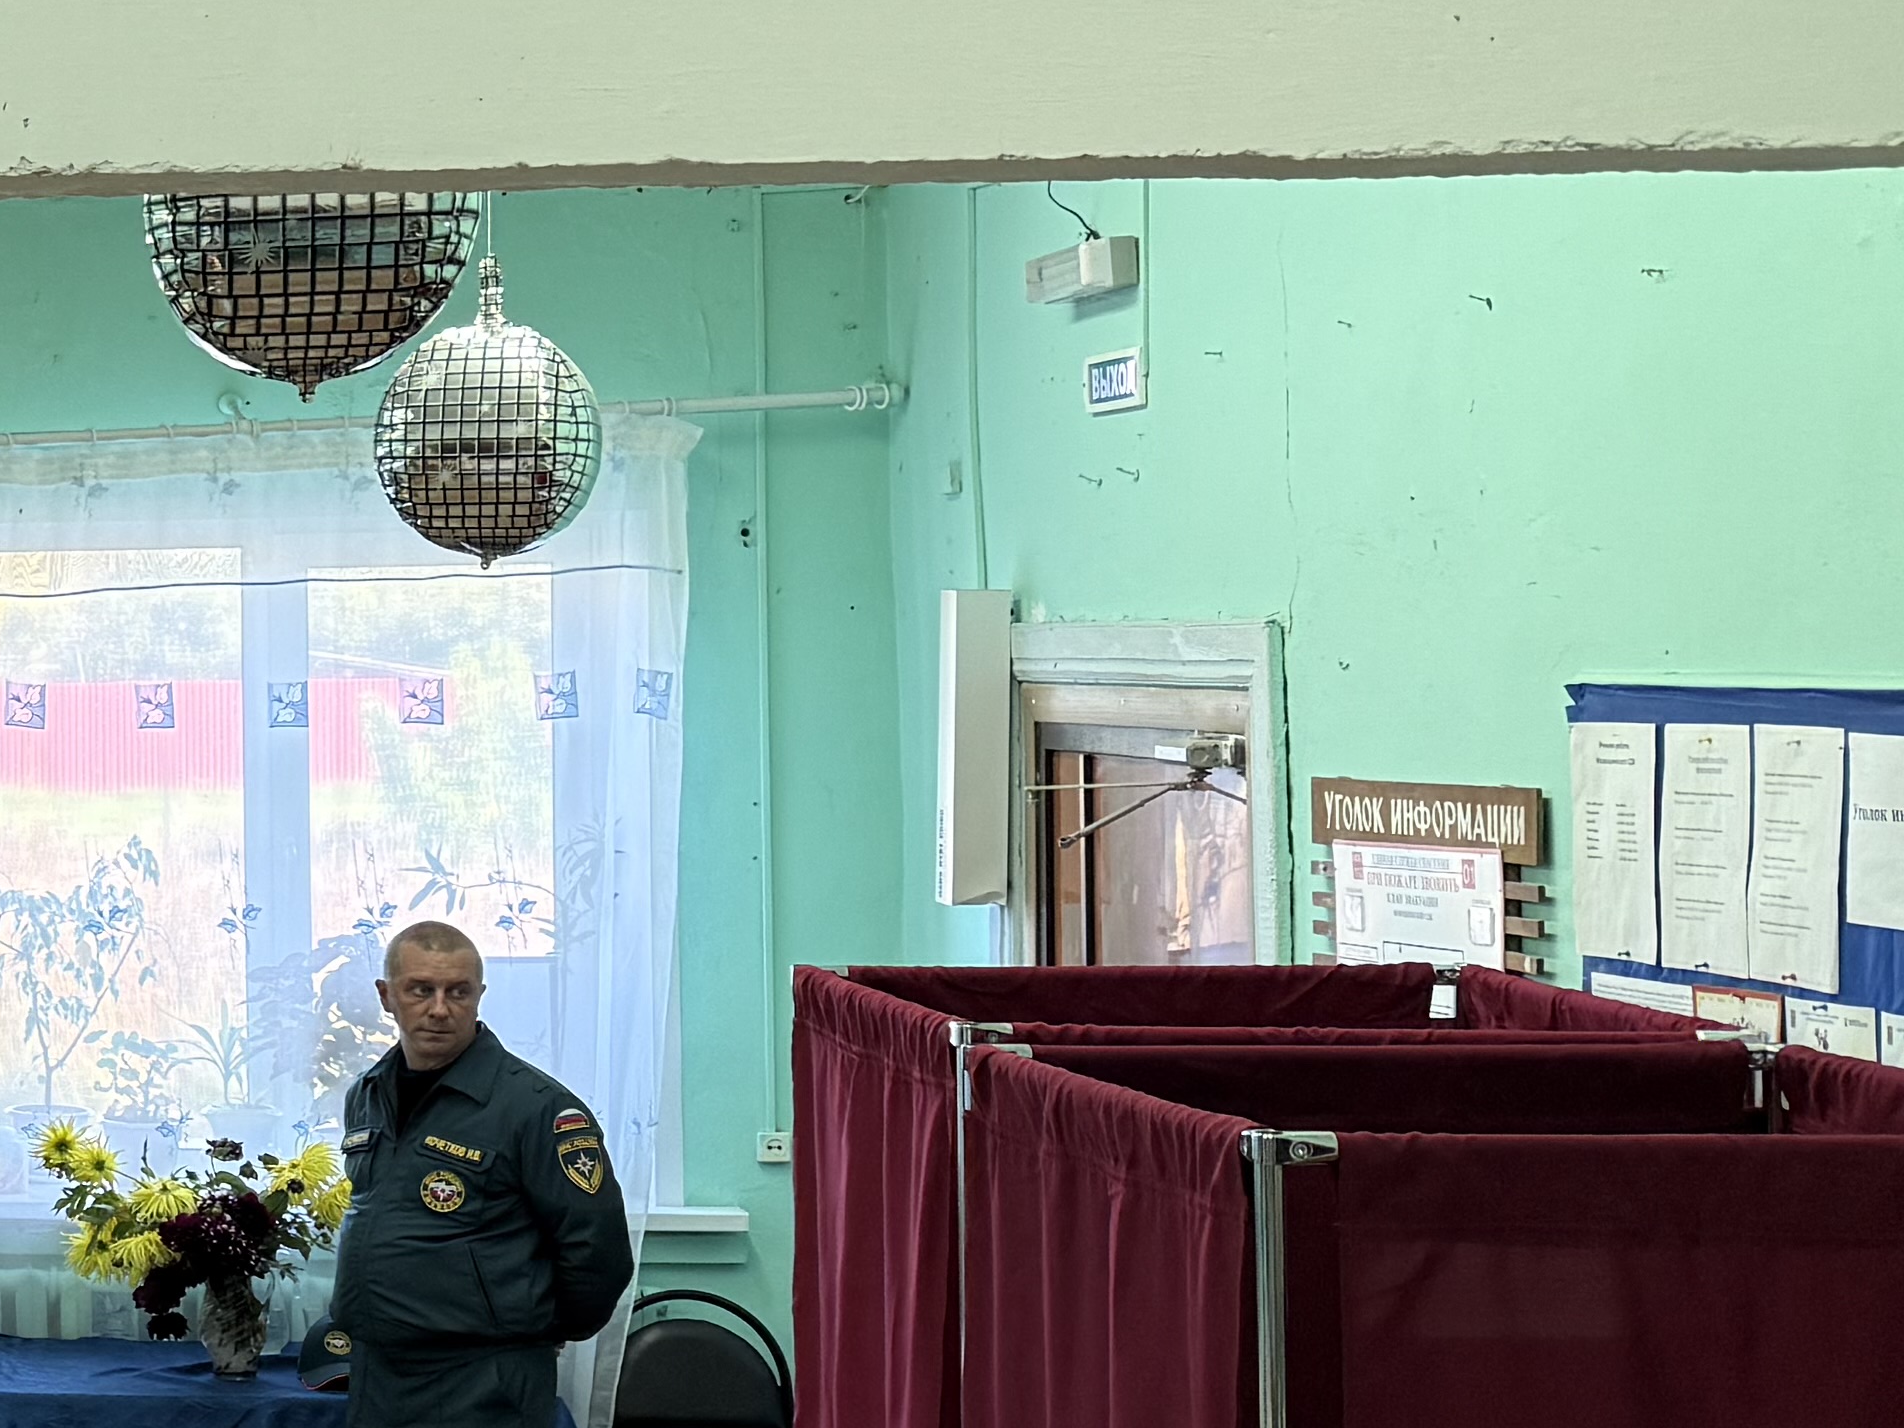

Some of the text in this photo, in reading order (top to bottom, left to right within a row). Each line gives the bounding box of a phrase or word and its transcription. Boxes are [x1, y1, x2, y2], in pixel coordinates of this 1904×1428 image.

[1092, 360, 1136, 400] ВЫХОД
[1324, 791, 1525, 848] УГОЛОК ИНФОРМАЦИИ
